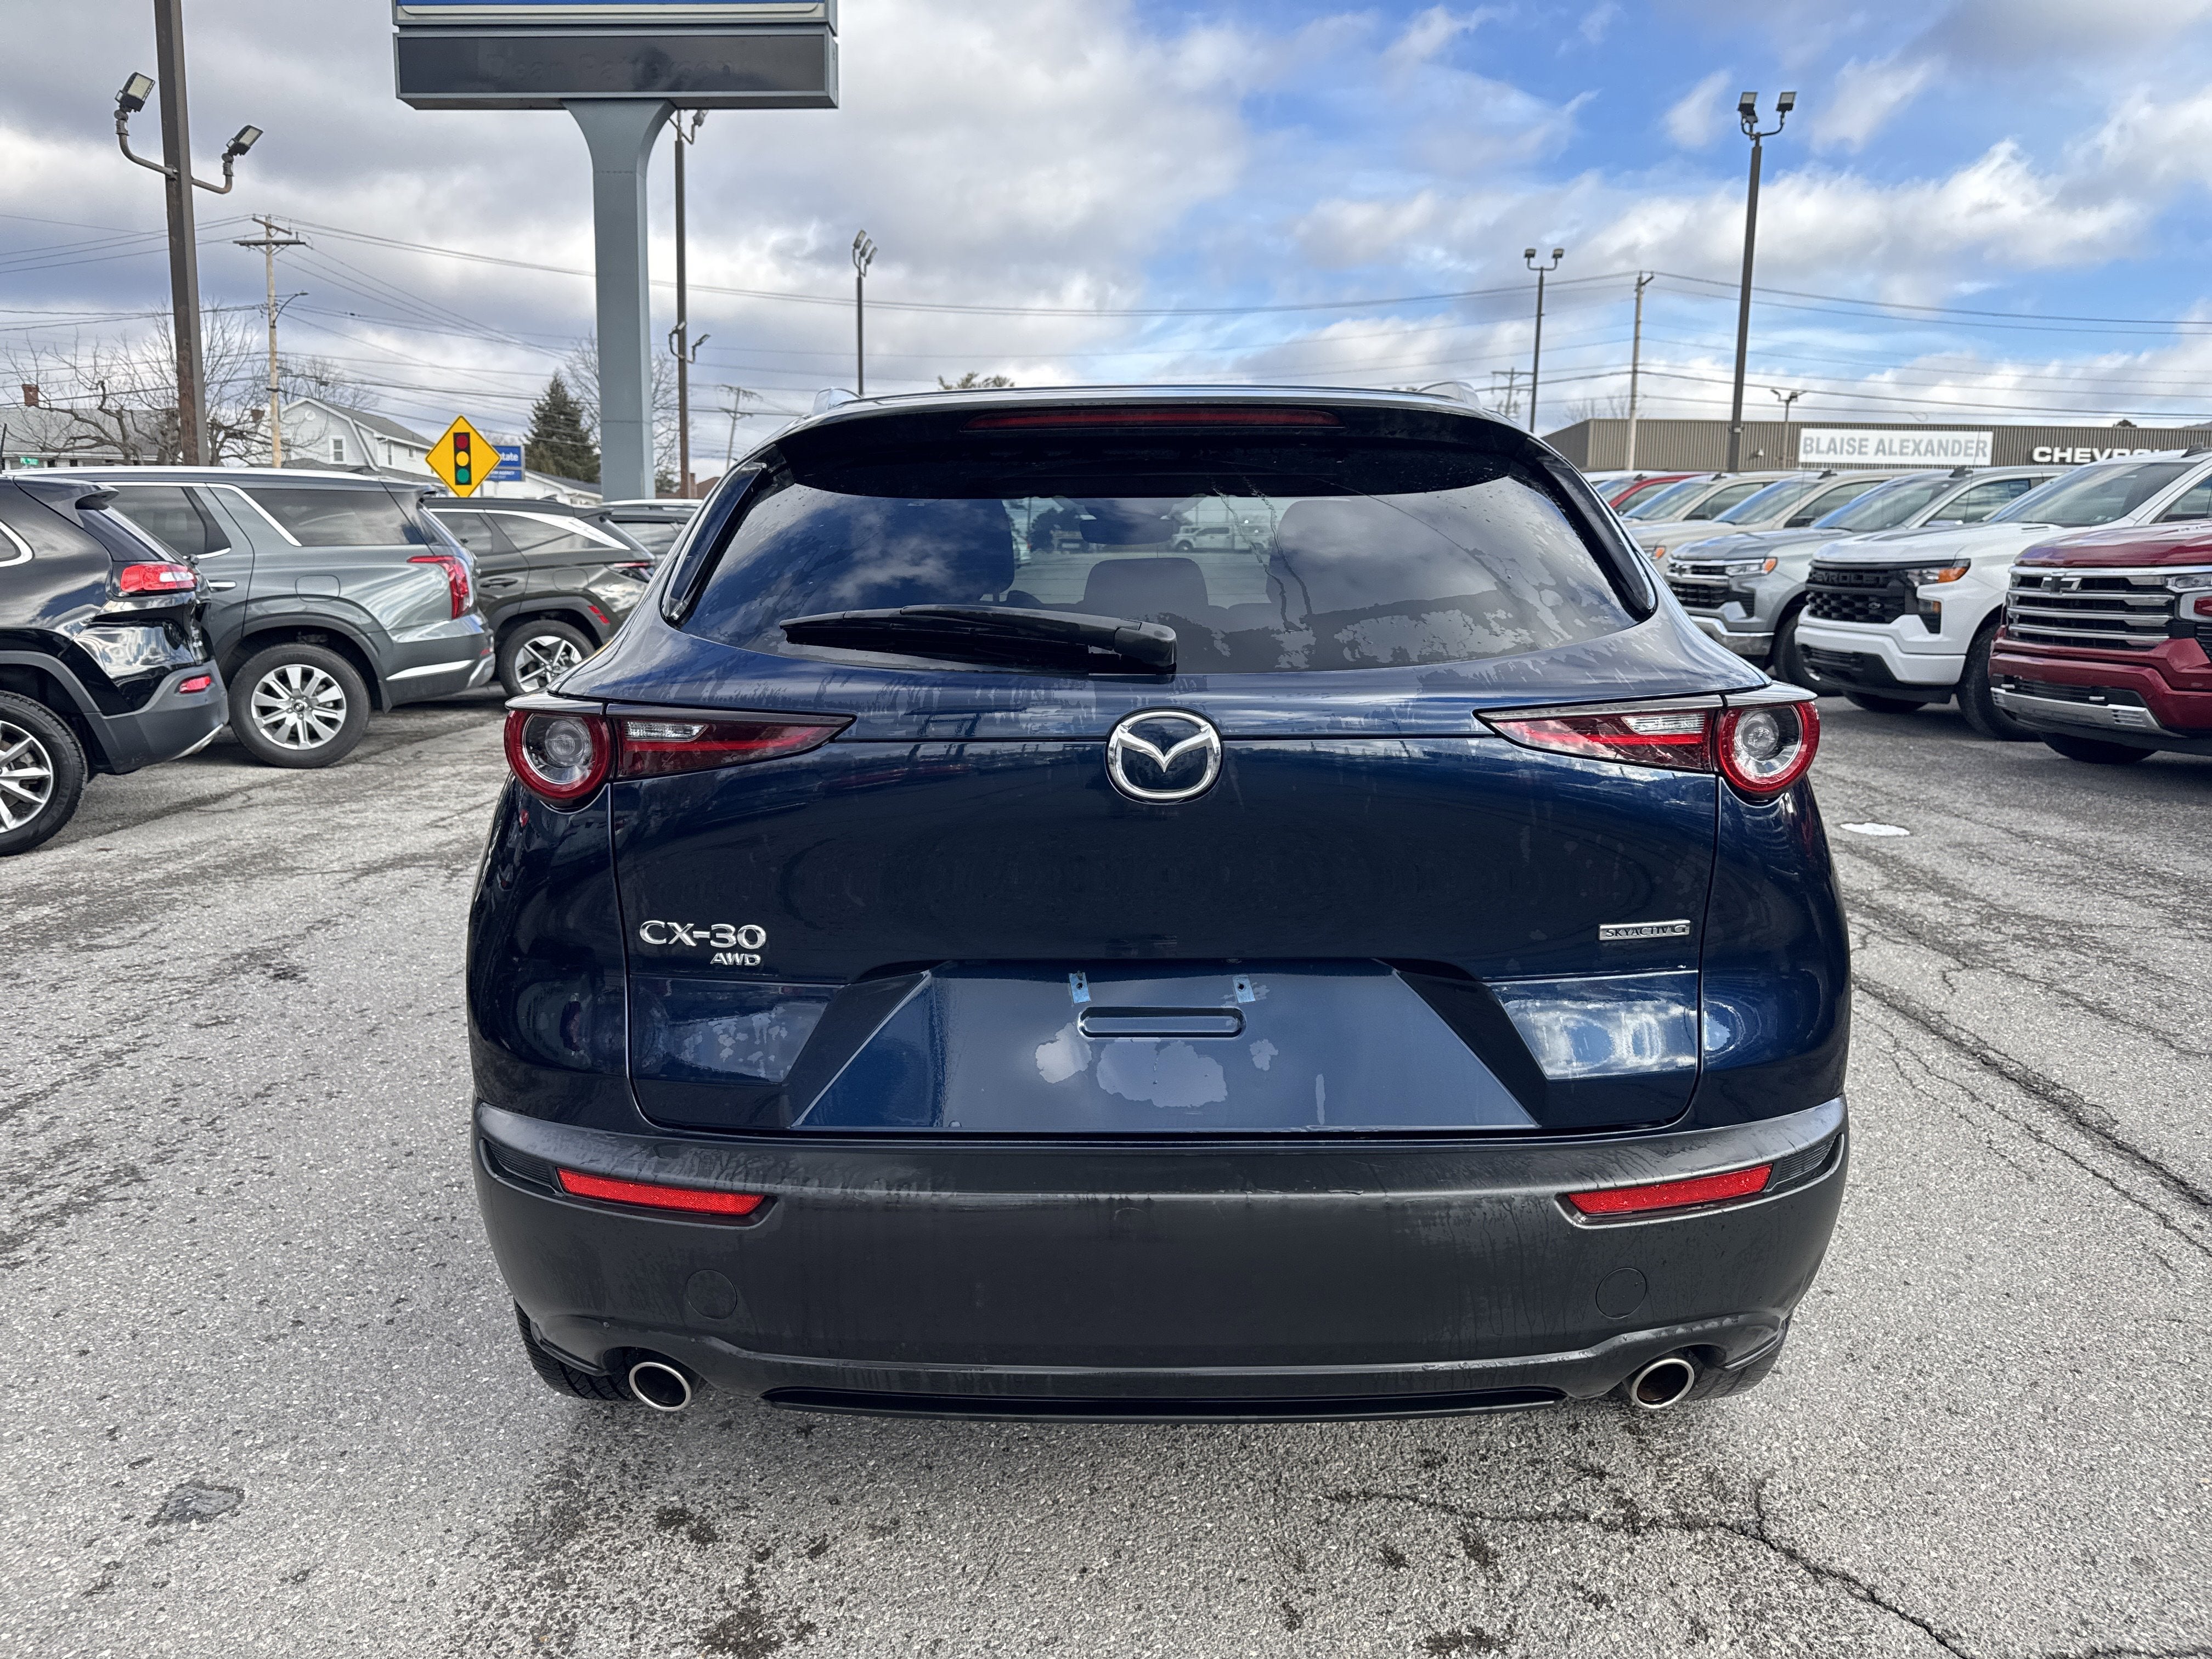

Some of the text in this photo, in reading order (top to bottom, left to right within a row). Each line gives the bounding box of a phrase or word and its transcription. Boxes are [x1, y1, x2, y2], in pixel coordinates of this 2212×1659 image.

[1802, 437, 1988, 458] BLAISE ALEXANDER
[2032, 446, 2160, 463] CHEVR
[500, 452, 519, 461] tate
[639, 920, 767, 950] CX-30
[1605, 926, 1670, 938] SKYACTIV
[710, 952, 761, 966] AWD
